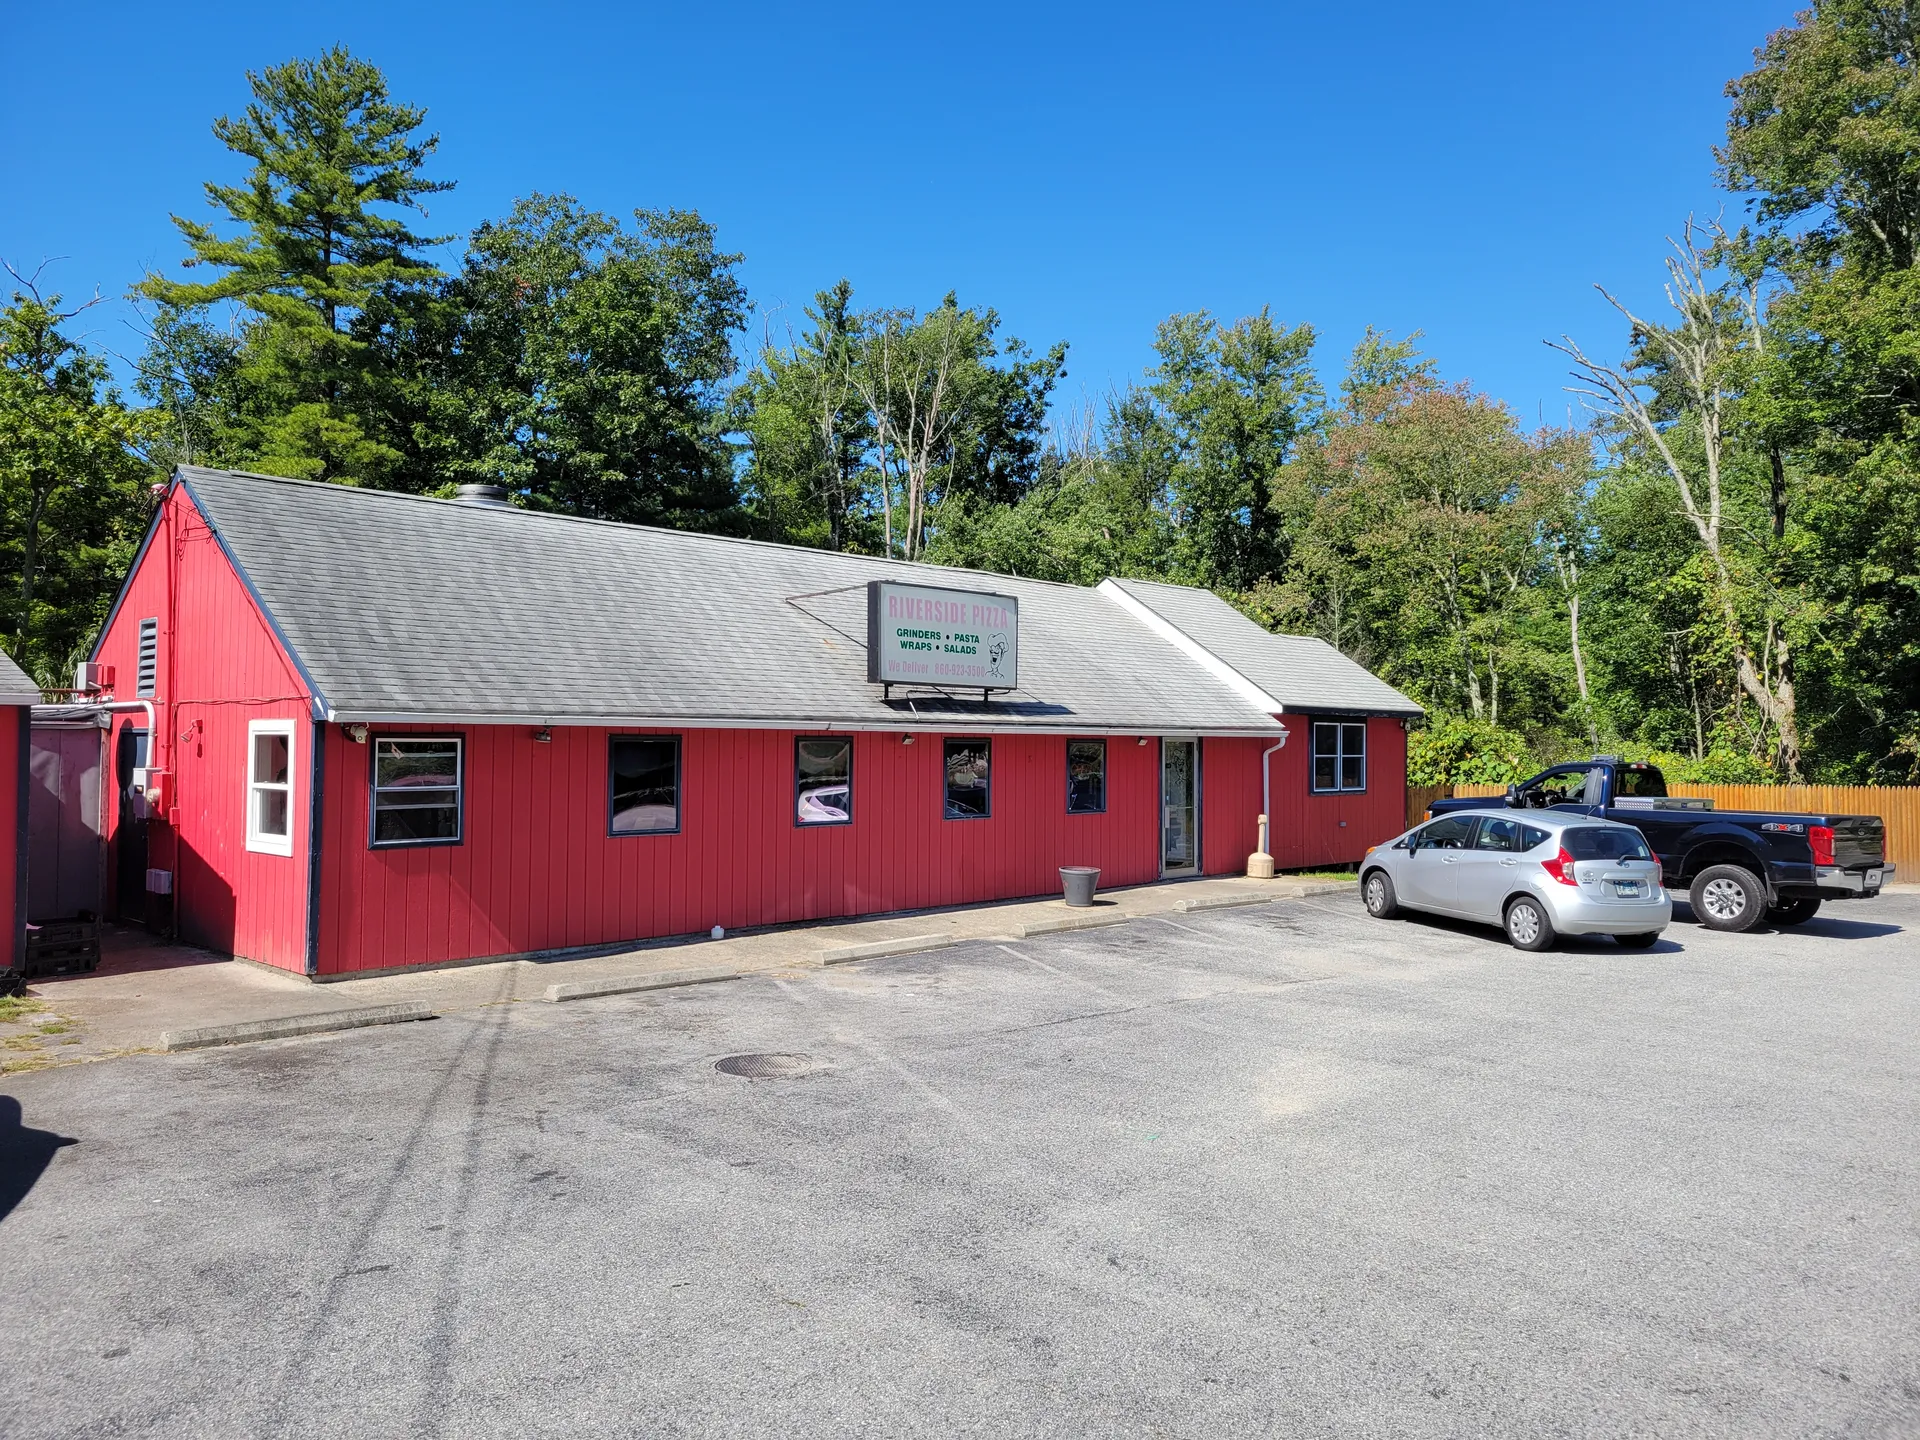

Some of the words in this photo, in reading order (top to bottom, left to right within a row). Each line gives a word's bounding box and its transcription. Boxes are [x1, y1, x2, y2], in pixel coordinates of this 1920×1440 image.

[889, 596, 966, 625] RIVERSIDE
[973, 604, 1008, 629] PIZZA
[896, 628, 941, 640] GRINDERS
[954, 633, 980, 643] PASTA
[900, 640, 932, 651] WRAPS
[944, 644, 977, 655] SALADS
[888, 659, 900, 672] We
[902, 661, 928, 674] Deliver
